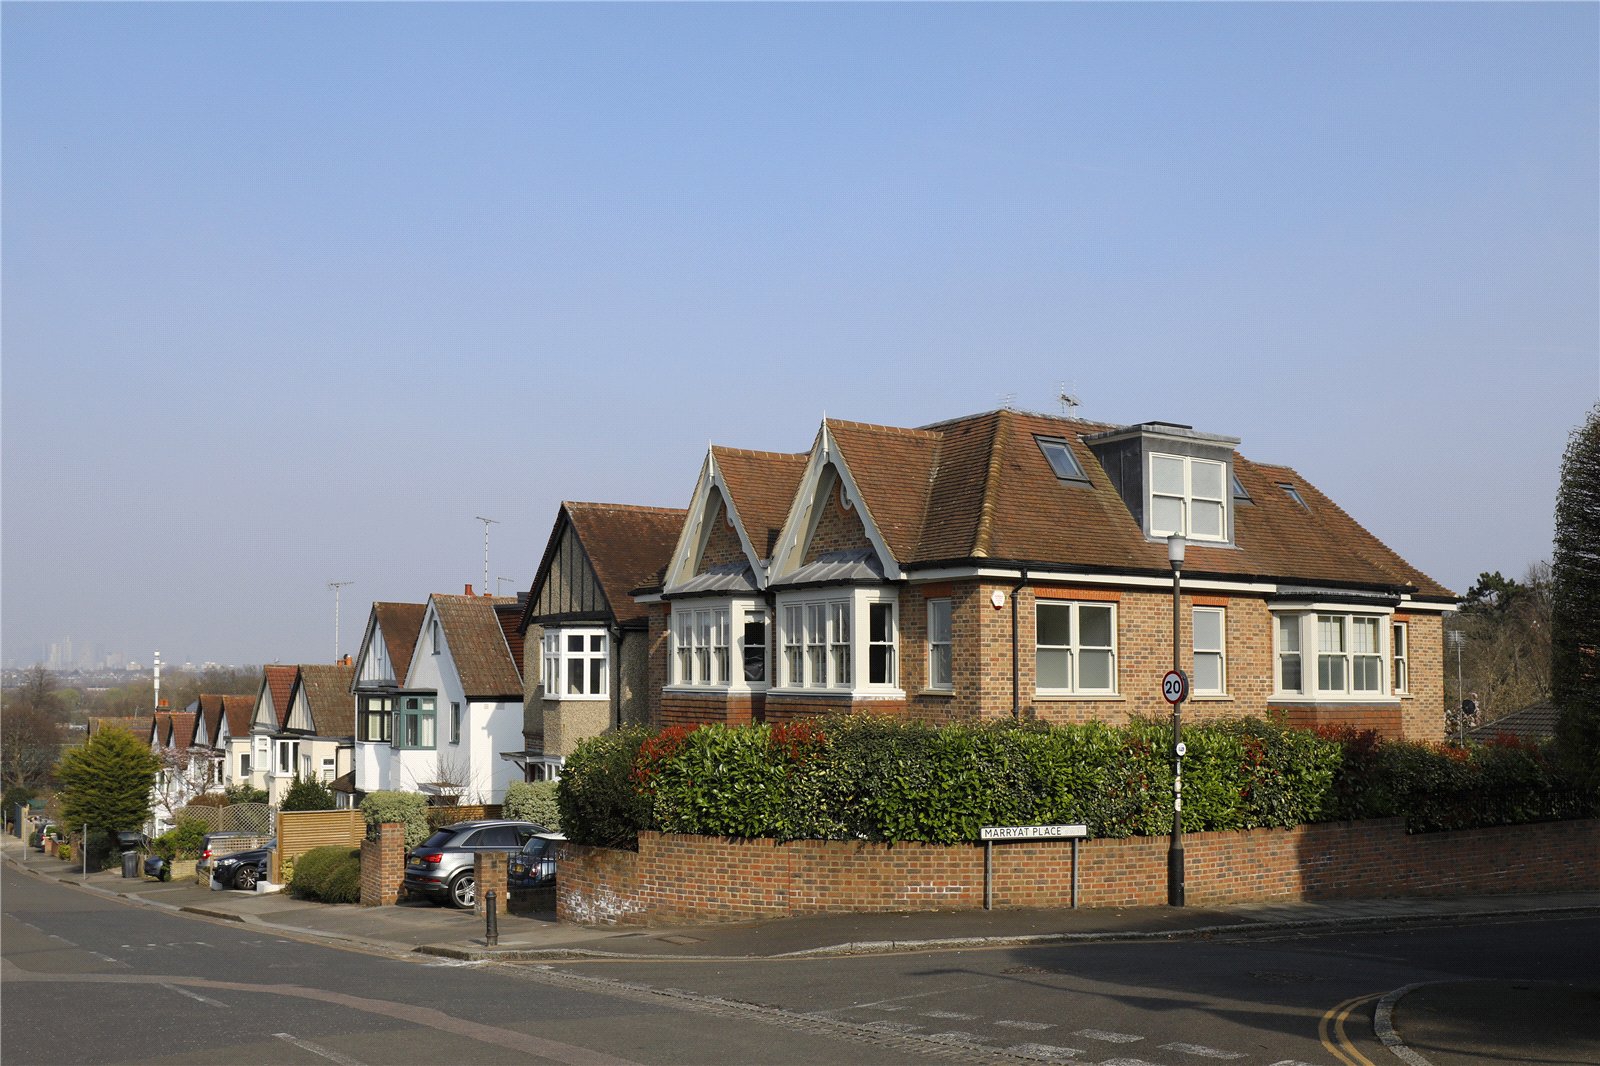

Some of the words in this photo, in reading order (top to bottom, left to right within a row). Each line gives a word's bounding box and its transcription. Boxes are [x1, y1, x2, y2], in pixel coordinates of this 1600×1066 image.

[1165, 681, 1180, 694] 20
[985, 828, 1029, 837] MARRYAT
[1032, 827, 1061, 836] PLACE
